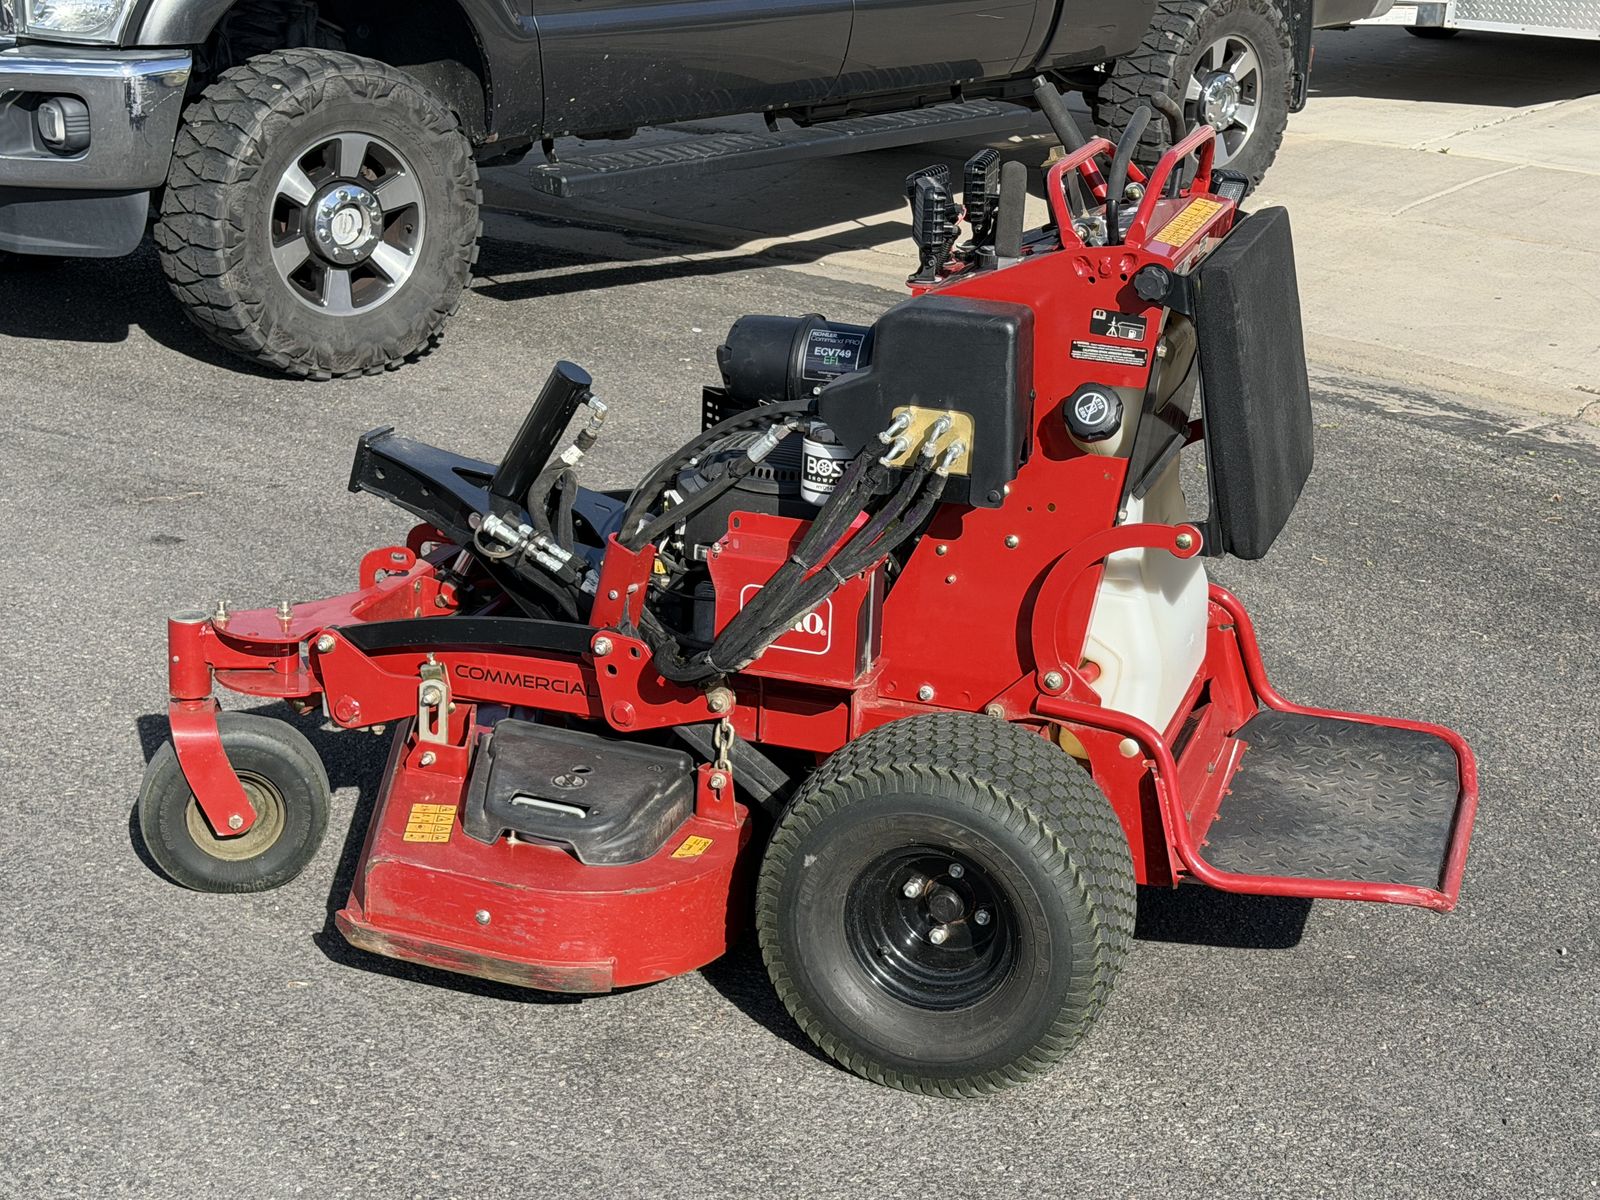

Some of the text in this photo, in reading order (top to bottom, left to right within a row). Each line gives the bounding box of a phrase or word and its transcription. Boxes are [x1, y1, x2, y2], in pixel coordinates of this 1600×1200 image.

[811, 335, 860, 346] Command PRO
[814, 346, 852, 358] ECV749
[823, 356, 838, 366] EFI
[455, 664, 599, 698] COMMERCIAL
